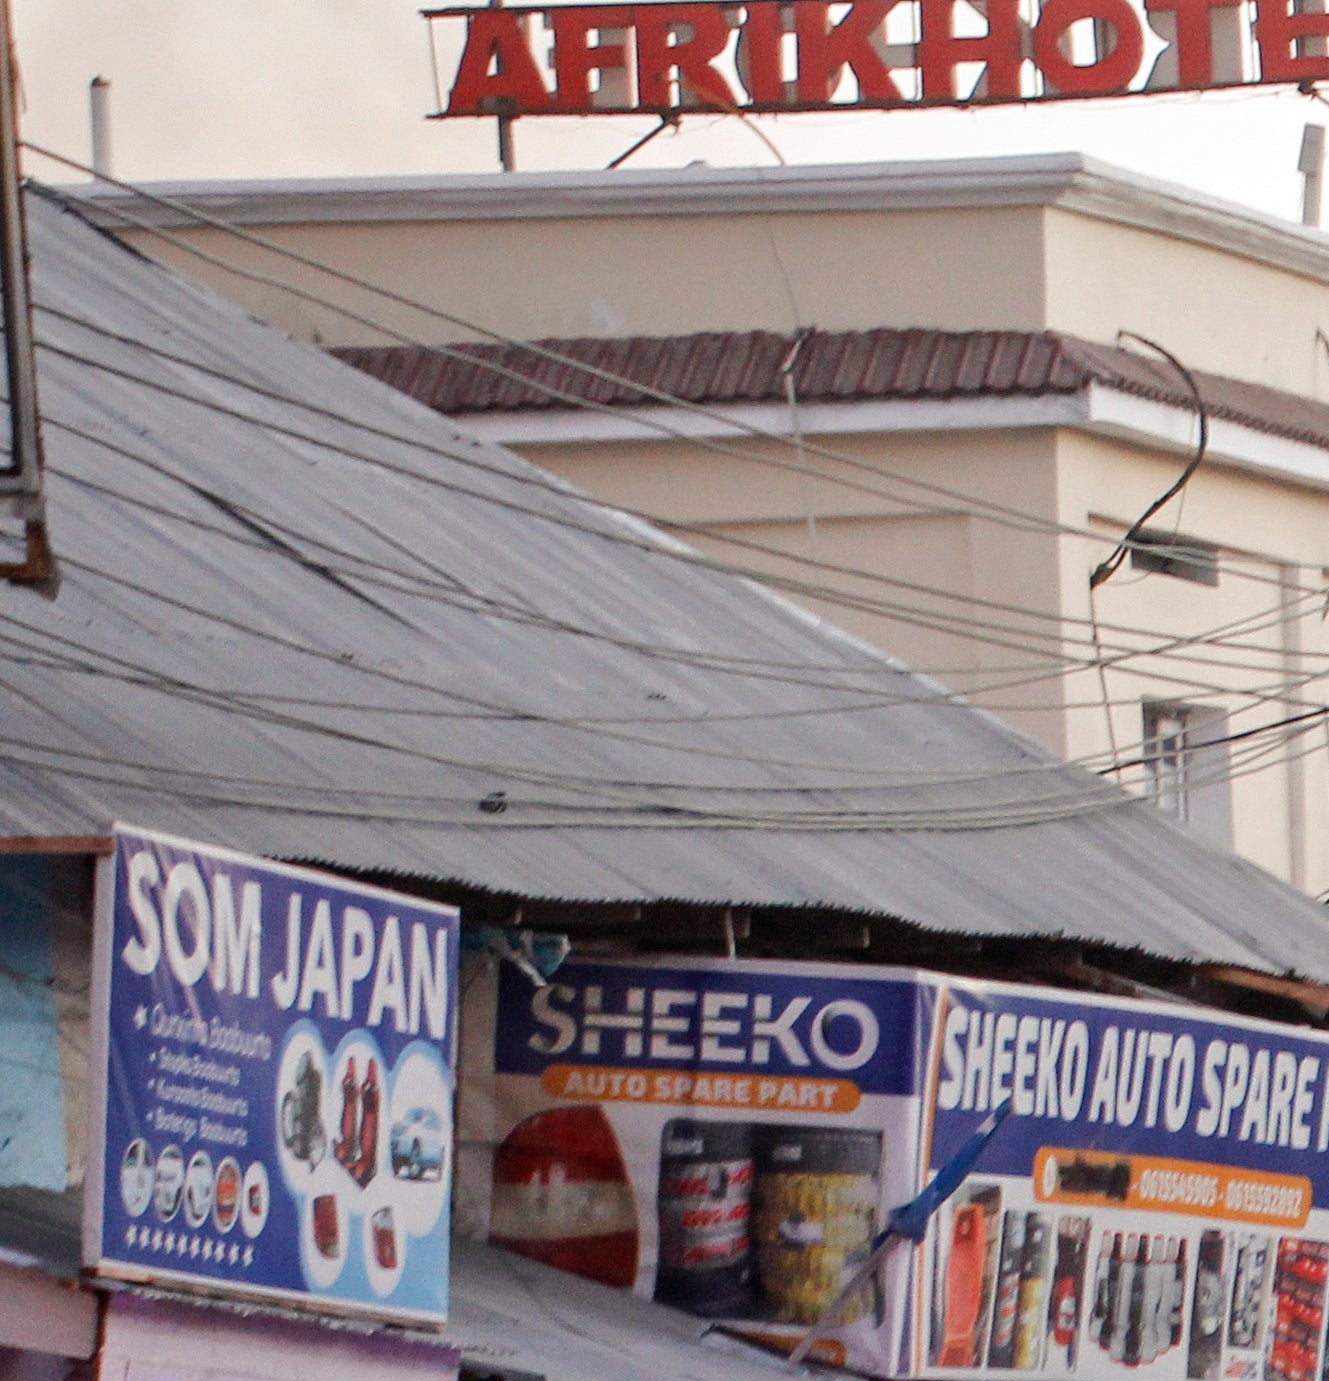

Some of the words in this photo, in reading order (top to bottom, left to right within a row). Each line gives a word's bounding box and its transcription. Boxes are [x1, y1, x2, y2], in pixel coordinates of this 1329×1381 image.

[122, 850, 263, 1000] SOM
[271, 891, 448, 1041] JAPAN
[526, 983, 880, 1071] SHEEKO
[939, 1005, 1090, 1122] SHEEKO
[1088, 1026, 1197, 1134] AUTO
[1195, 1039, 1323, 1151] SPARE
[563, 1070, 649, 1100] AUTO
[654, 1075, 752, 1104] SPARE
[758, 1080, 839, 1109] PART
